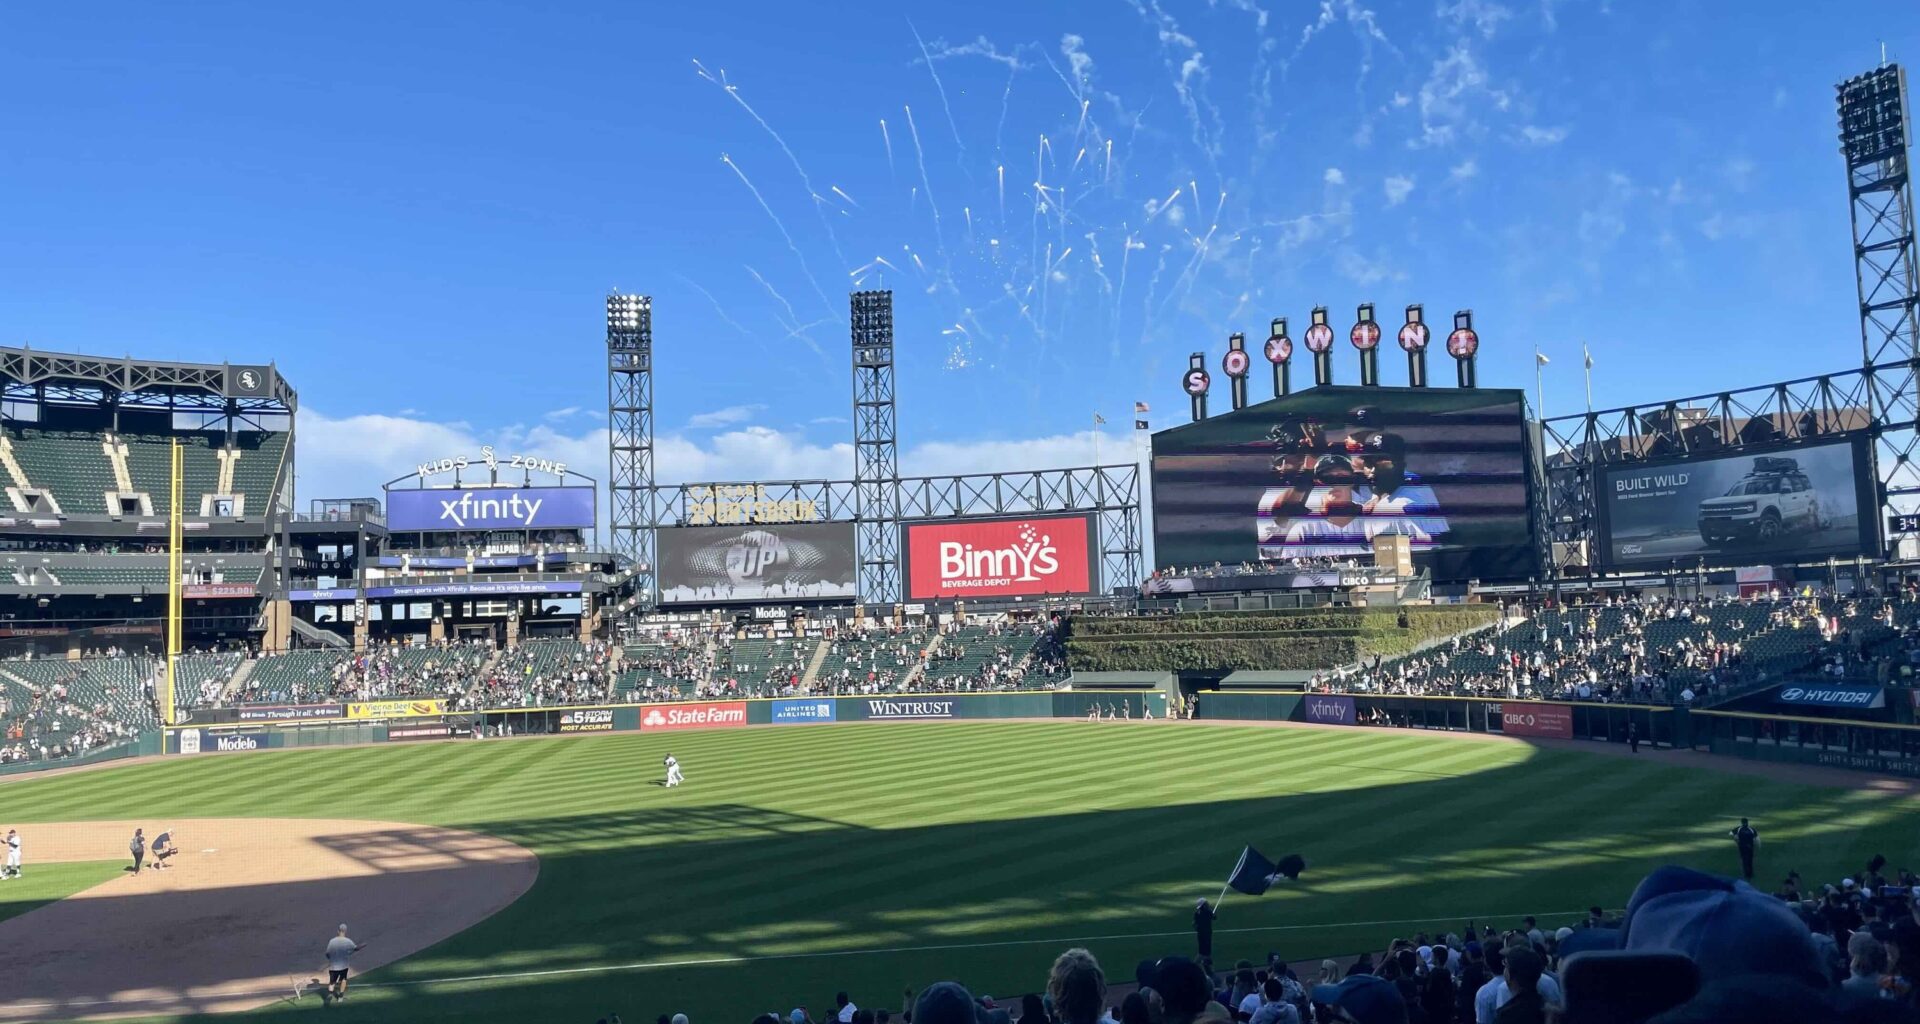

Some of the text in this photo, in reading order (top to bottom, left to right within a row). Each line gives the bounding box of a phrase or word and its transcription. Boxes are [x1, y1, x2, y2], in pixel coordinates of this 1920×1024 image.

[417, 456, 468, 477] KIDS
[510, 455, 567, 476] ZONE
[1616, 477, 1651, 492] BUILT
[440, 492, 543, 527] xfinity
[492, 532, 519, 541] BETTER
[1621, 544, 1642, 554] Ford
[414, 588, 432, 596] sports
[470, 584, 495, 592] Because
[506, 584, 519, 592] only
[942, 578, 1011, 588] BEVERAGE DEPOT
[755, 607, 787, 618] Modelo
[1804, 689, 1872, 703] HYUNDAI
[868, 700, 952, 715] WINTRUST
[1312, 700, 1346, 720] xfinity
[574, 711, 584, 724] 5
[668, 710, 744, 725] State Farm
[1504, 714, 1525, 724] CIBC
[217, 736, 256, 751] Modelo
